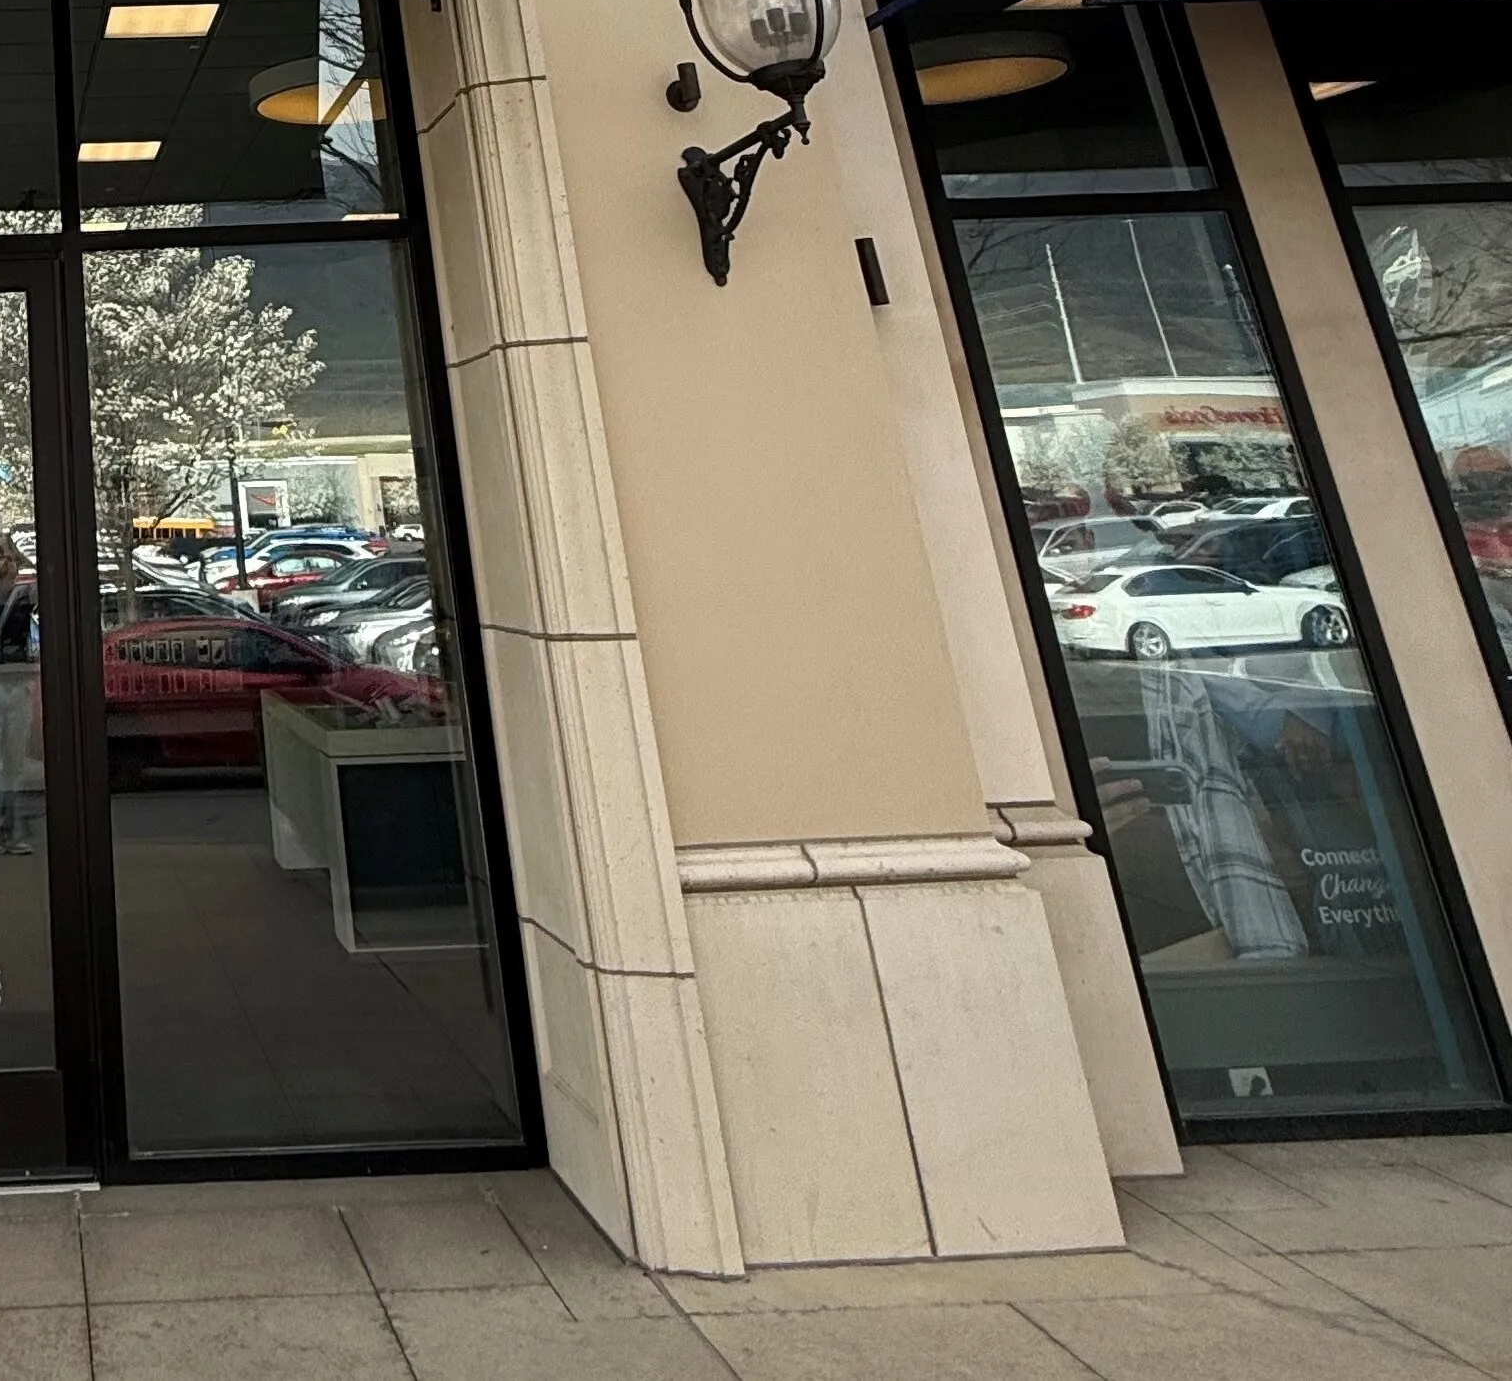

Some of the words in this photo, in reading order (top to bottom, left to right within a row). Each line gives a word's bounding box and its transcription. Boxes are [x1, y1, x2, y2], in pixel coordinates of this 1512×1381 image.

[1300, 847, 1378, 867] Connect
[1320, 872, 1389, 901] Chang
[1318, 903, 1398, 929] Everyth
